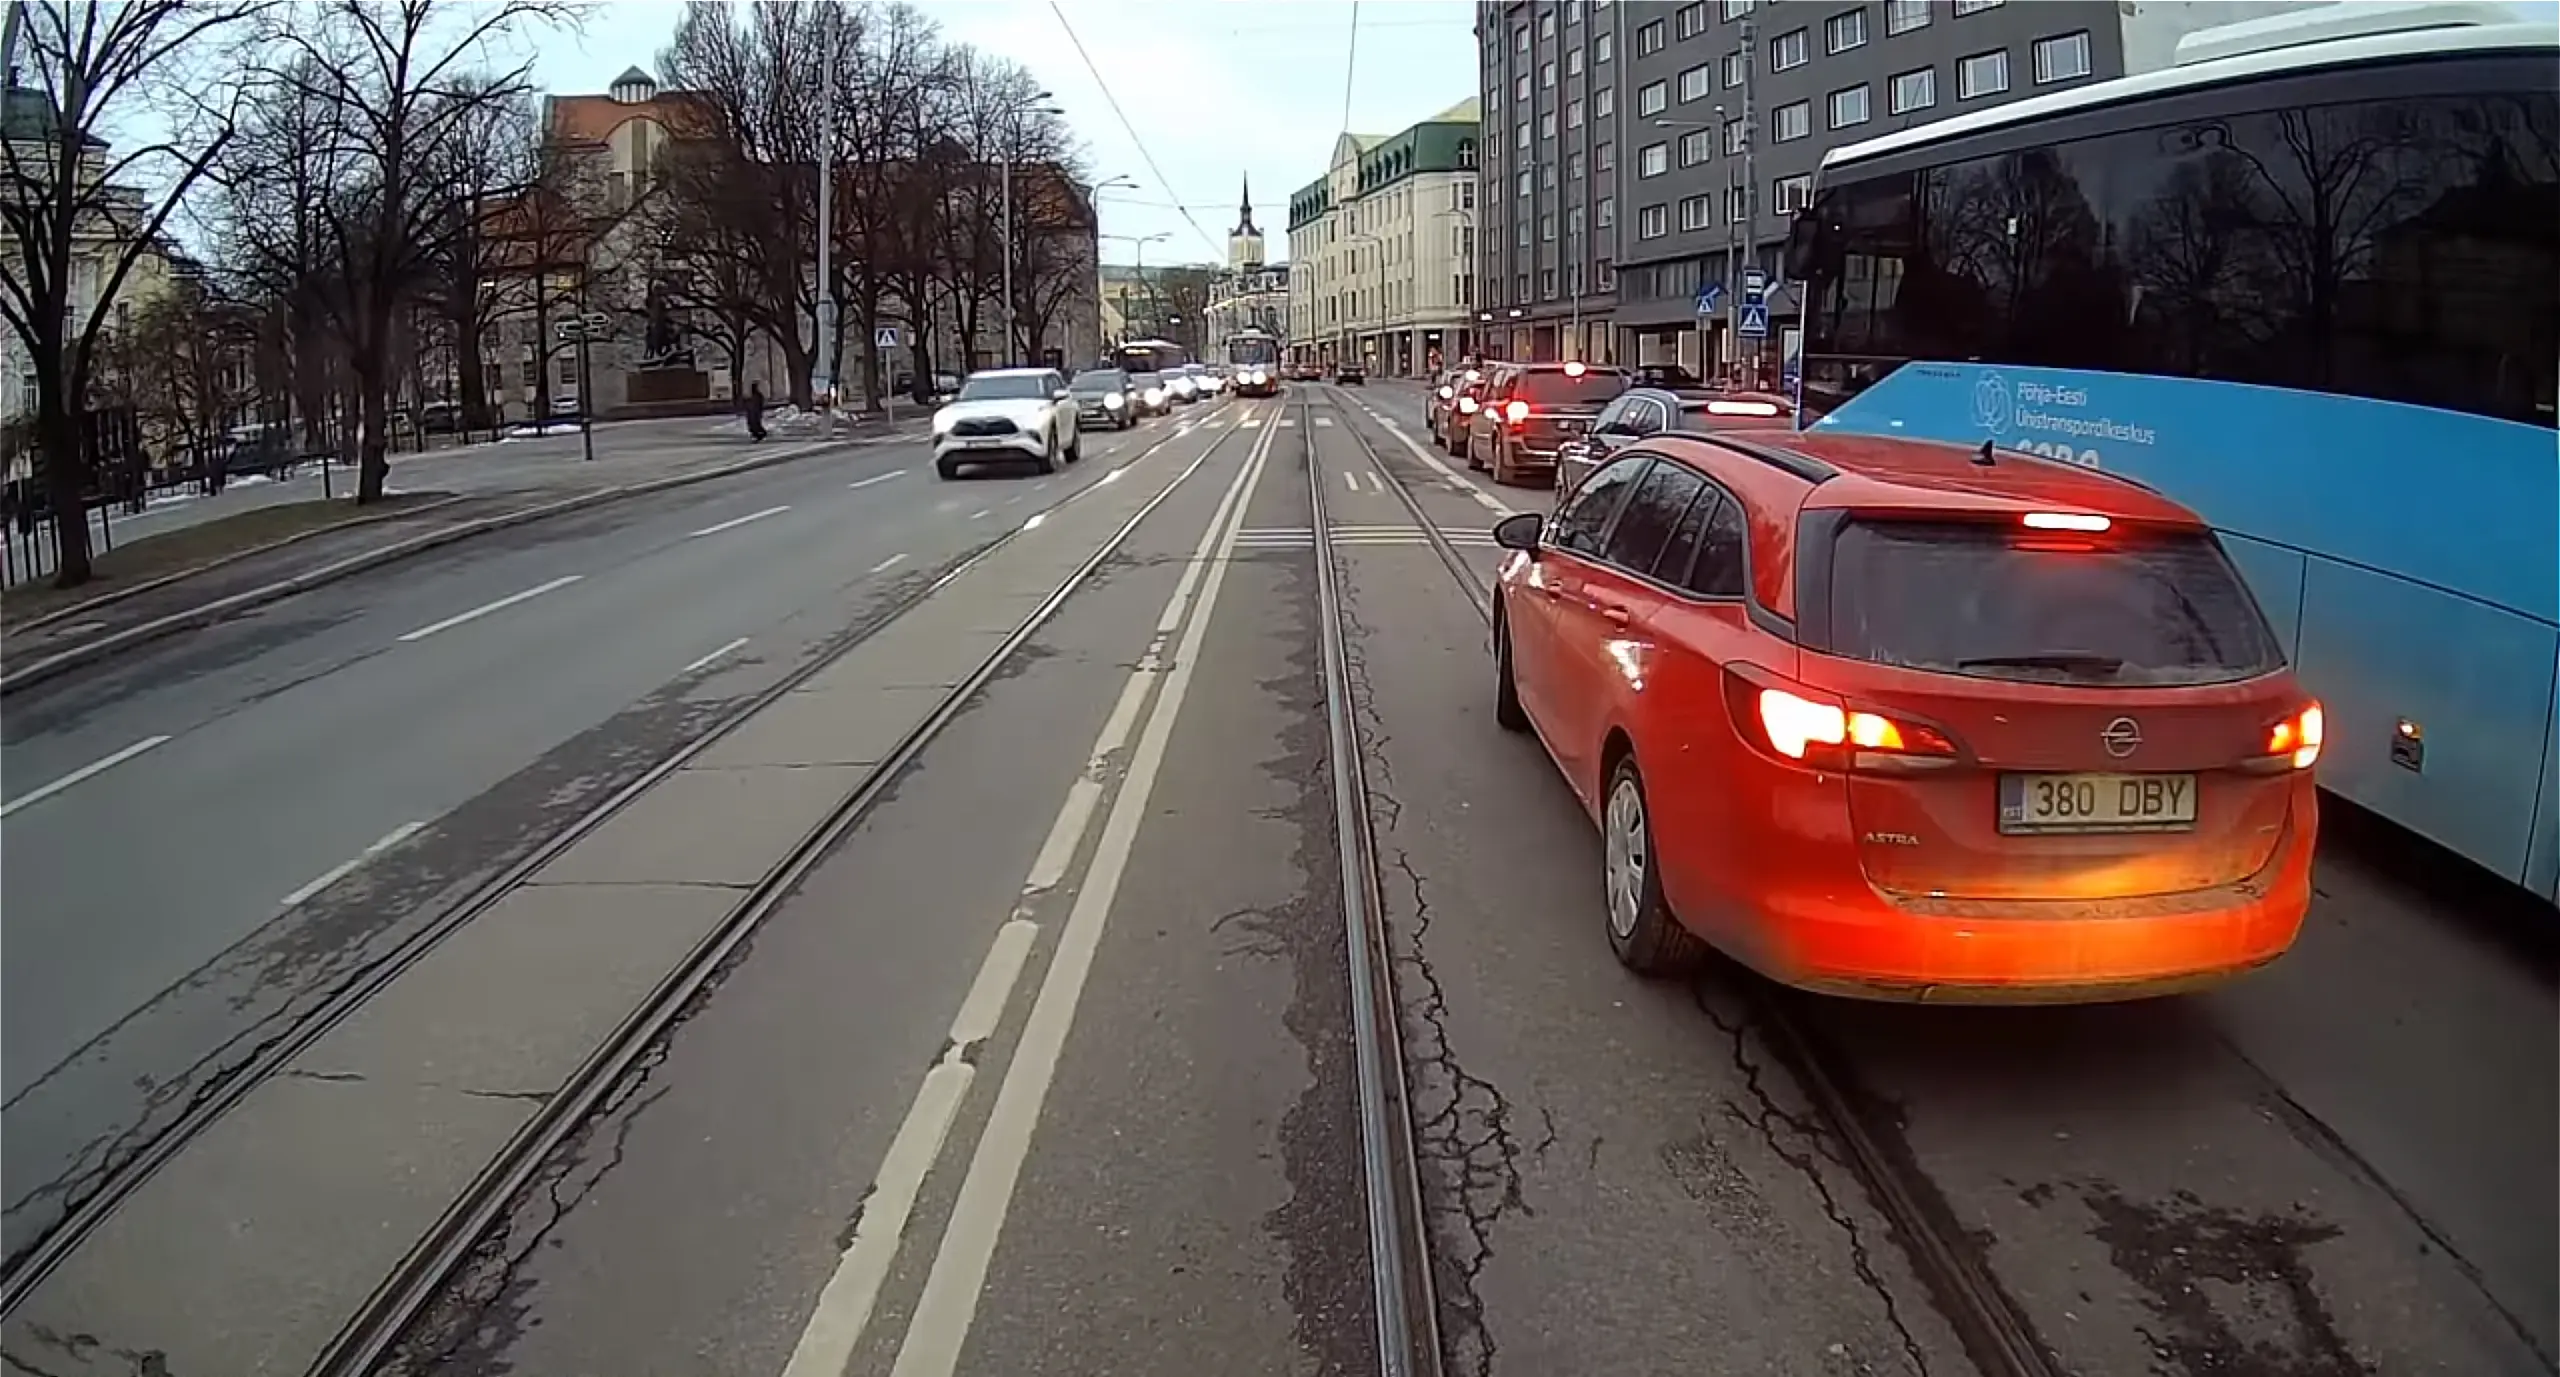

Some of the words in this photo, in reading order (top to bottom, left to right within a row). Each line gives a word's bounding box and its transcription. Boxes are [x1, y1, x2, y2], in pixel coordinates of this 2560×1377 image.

[2017, 381, 2088, 407] Põhja-Eesti
[2035, 779, 2095, 817] 380
[2118, 778, 2186, 817] DBY
[1864, 832, 1920, 845] ASTRA
